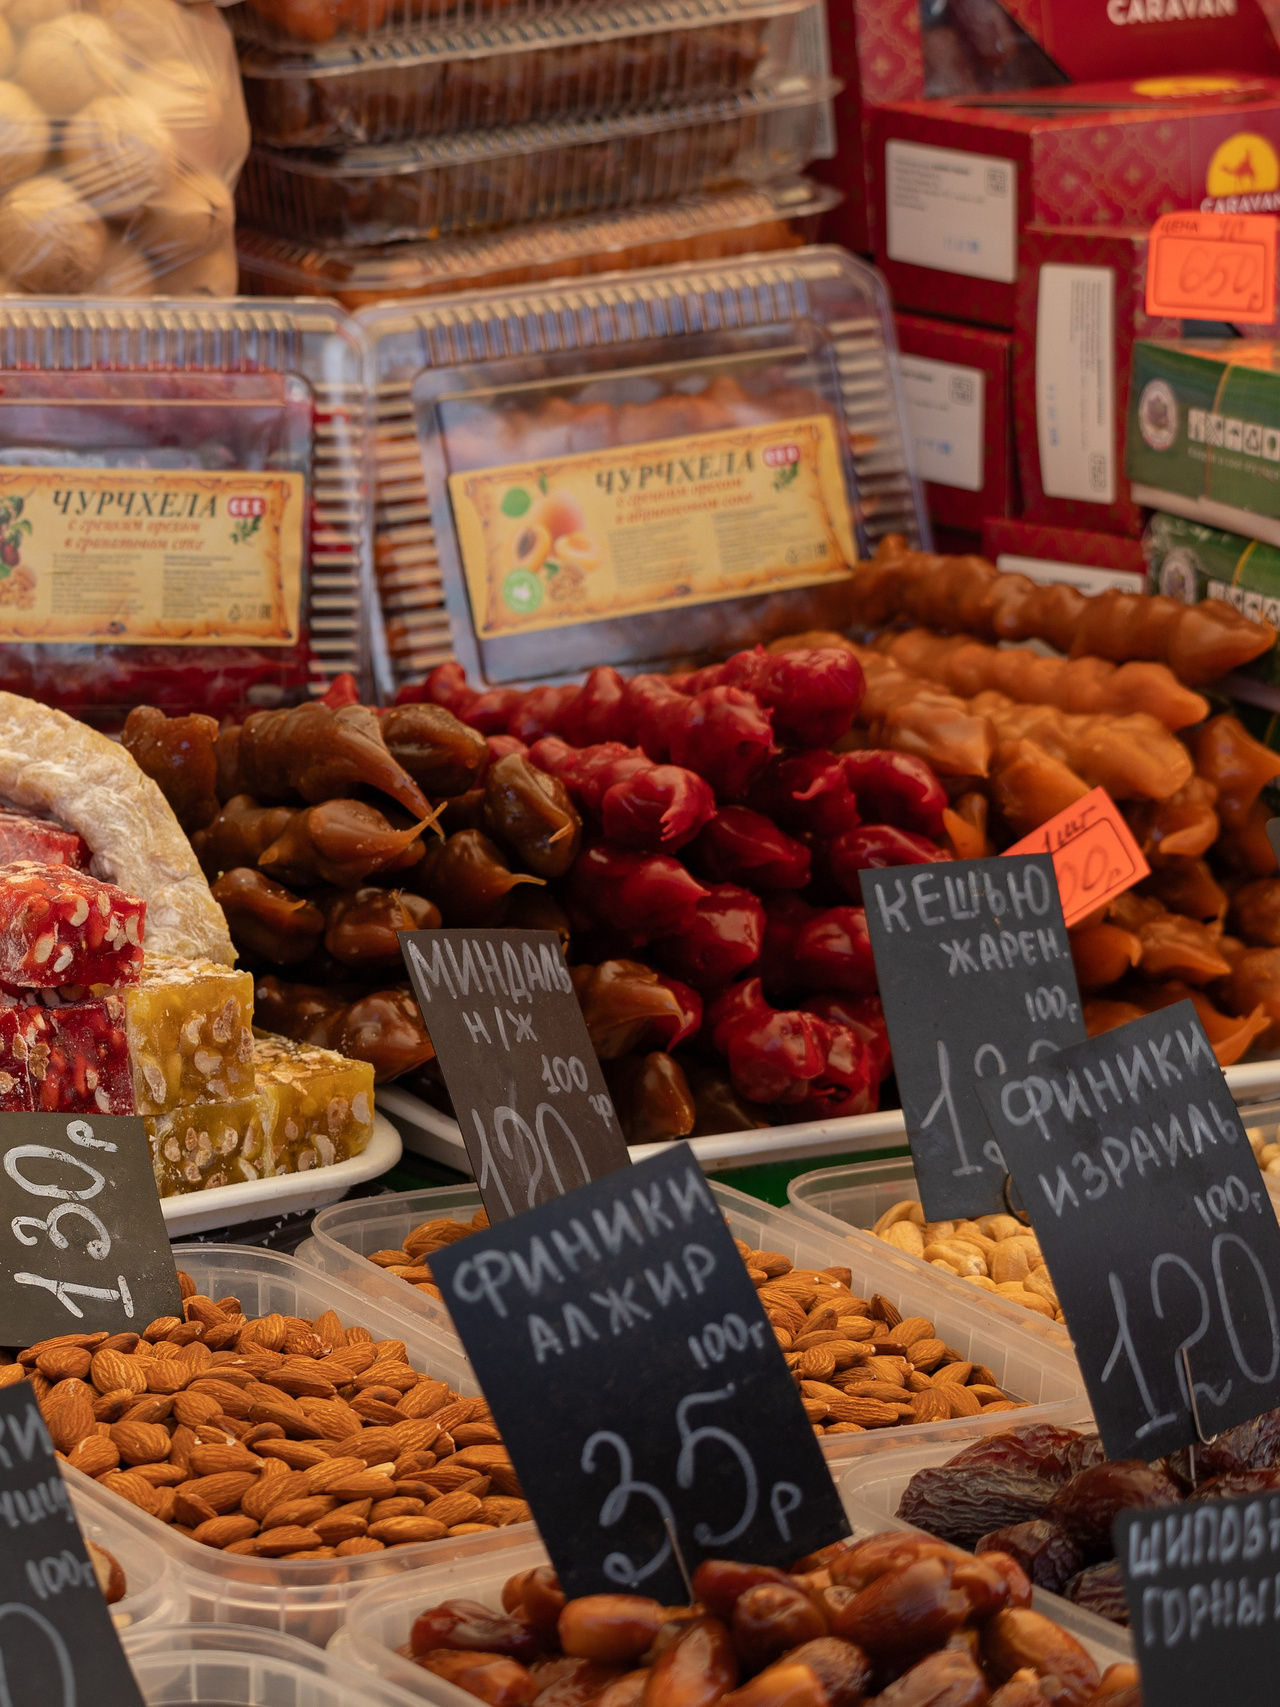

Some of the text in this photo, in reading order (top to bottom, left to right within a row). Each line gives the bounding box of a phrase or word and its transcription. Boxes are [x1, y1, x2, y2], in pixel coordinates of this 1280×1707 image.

[1106, 0, 1238, 26] CARAVAN
[52, 489, 219, 519] ЧУРЧХЕЛА
[595, 450, 754, 494] ЧУРЧХЕЛА
[874, 863, 1051, 933] КЕШЬЮ
[407, 938, 572, 1004] МИНДАЛЬ
[1000, 1022, 1217, 1140] ФИНИКИ
[1038, 1100, 1239, 1217] ИЗРАИЛЬ
[452, 1167, 717, 1318] ФИНИКИ
[527, 1243, 716, 1363] АЛЖИР
[1101, 1233, 1280, 1438] 120
